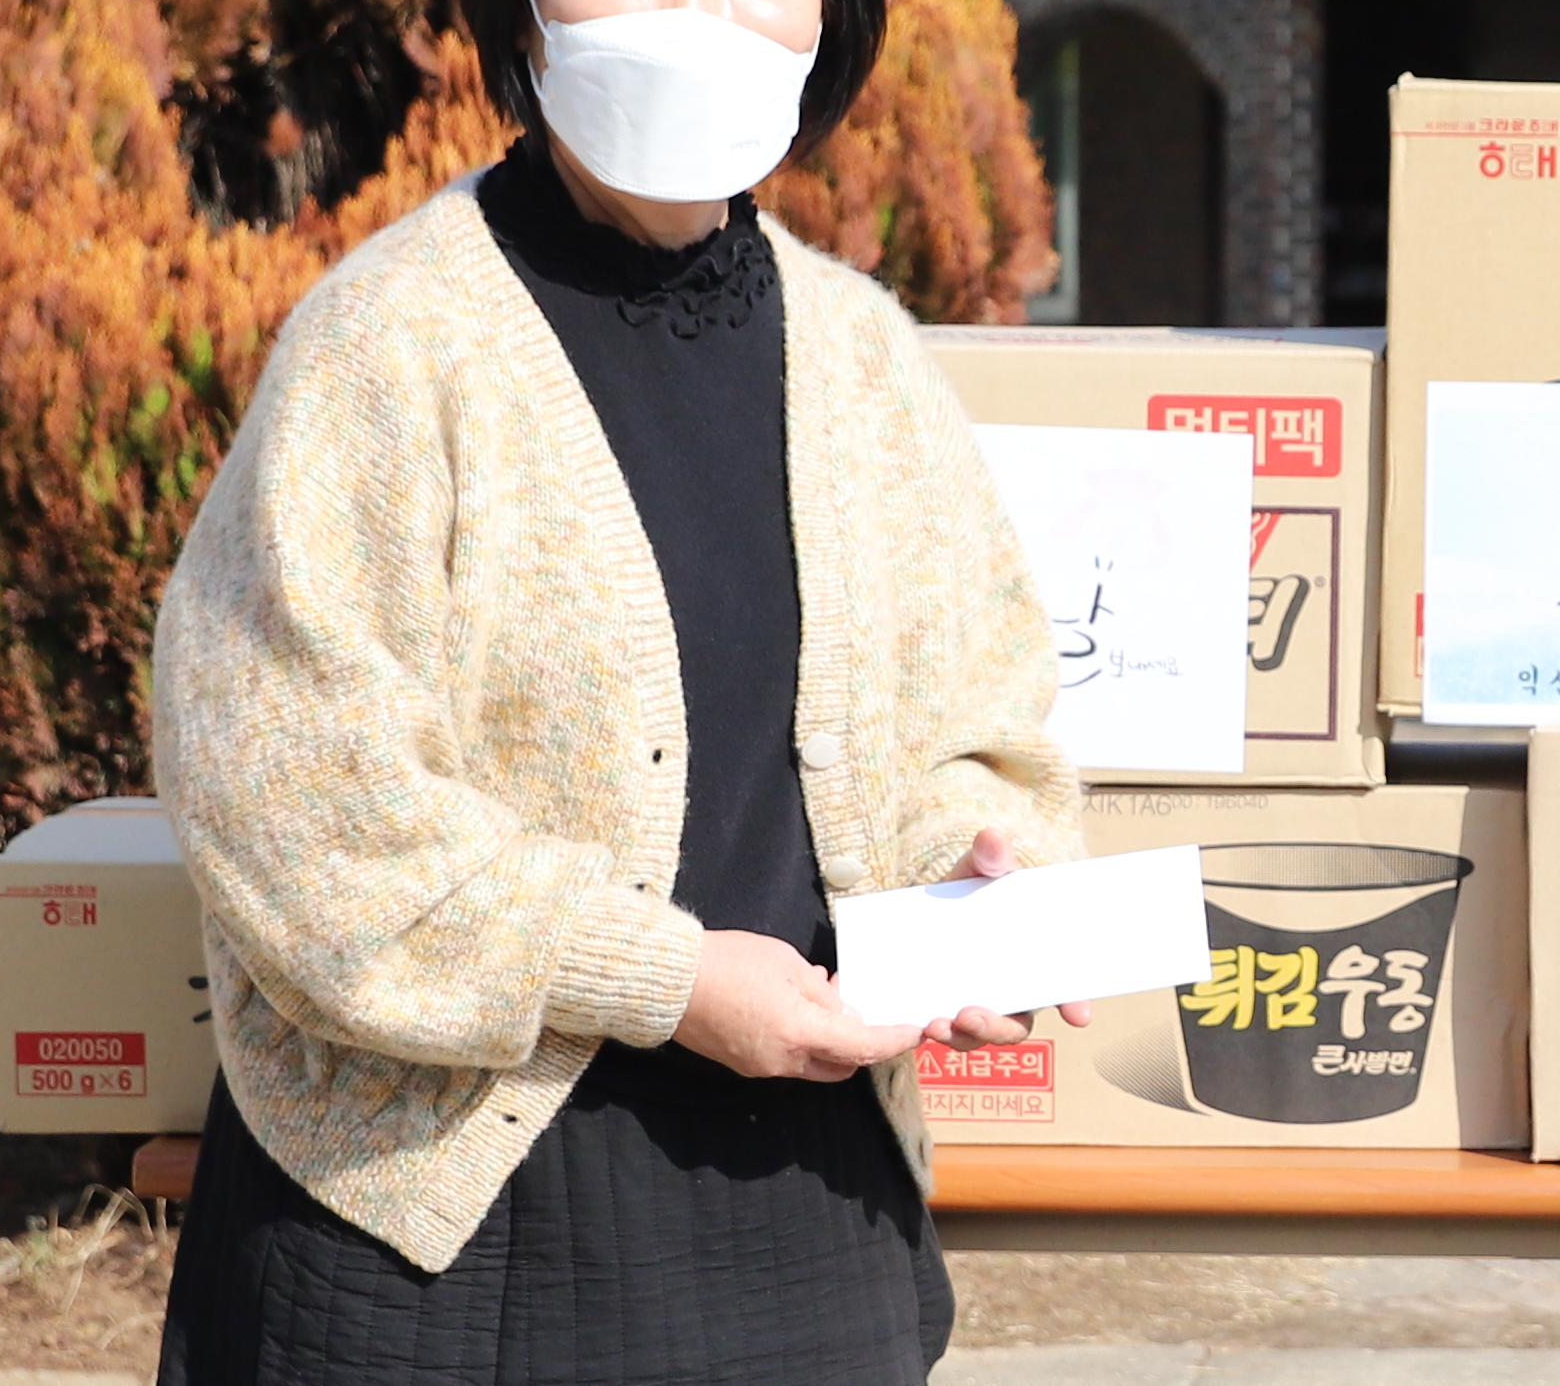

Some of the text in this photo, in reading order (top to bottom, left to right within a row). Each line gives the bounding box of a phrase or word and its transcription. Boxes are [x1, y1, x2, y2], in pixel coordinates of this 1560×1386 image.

[40, 1038, 122, 1060] 020050
[1311, 1044, 1414, 1075] 큰사발면
[945, 1050, 1044, 1078] 취급주의
[32, 1070, 72, 1090] 500
[982, 1094, 1045, 1116] 마세요
